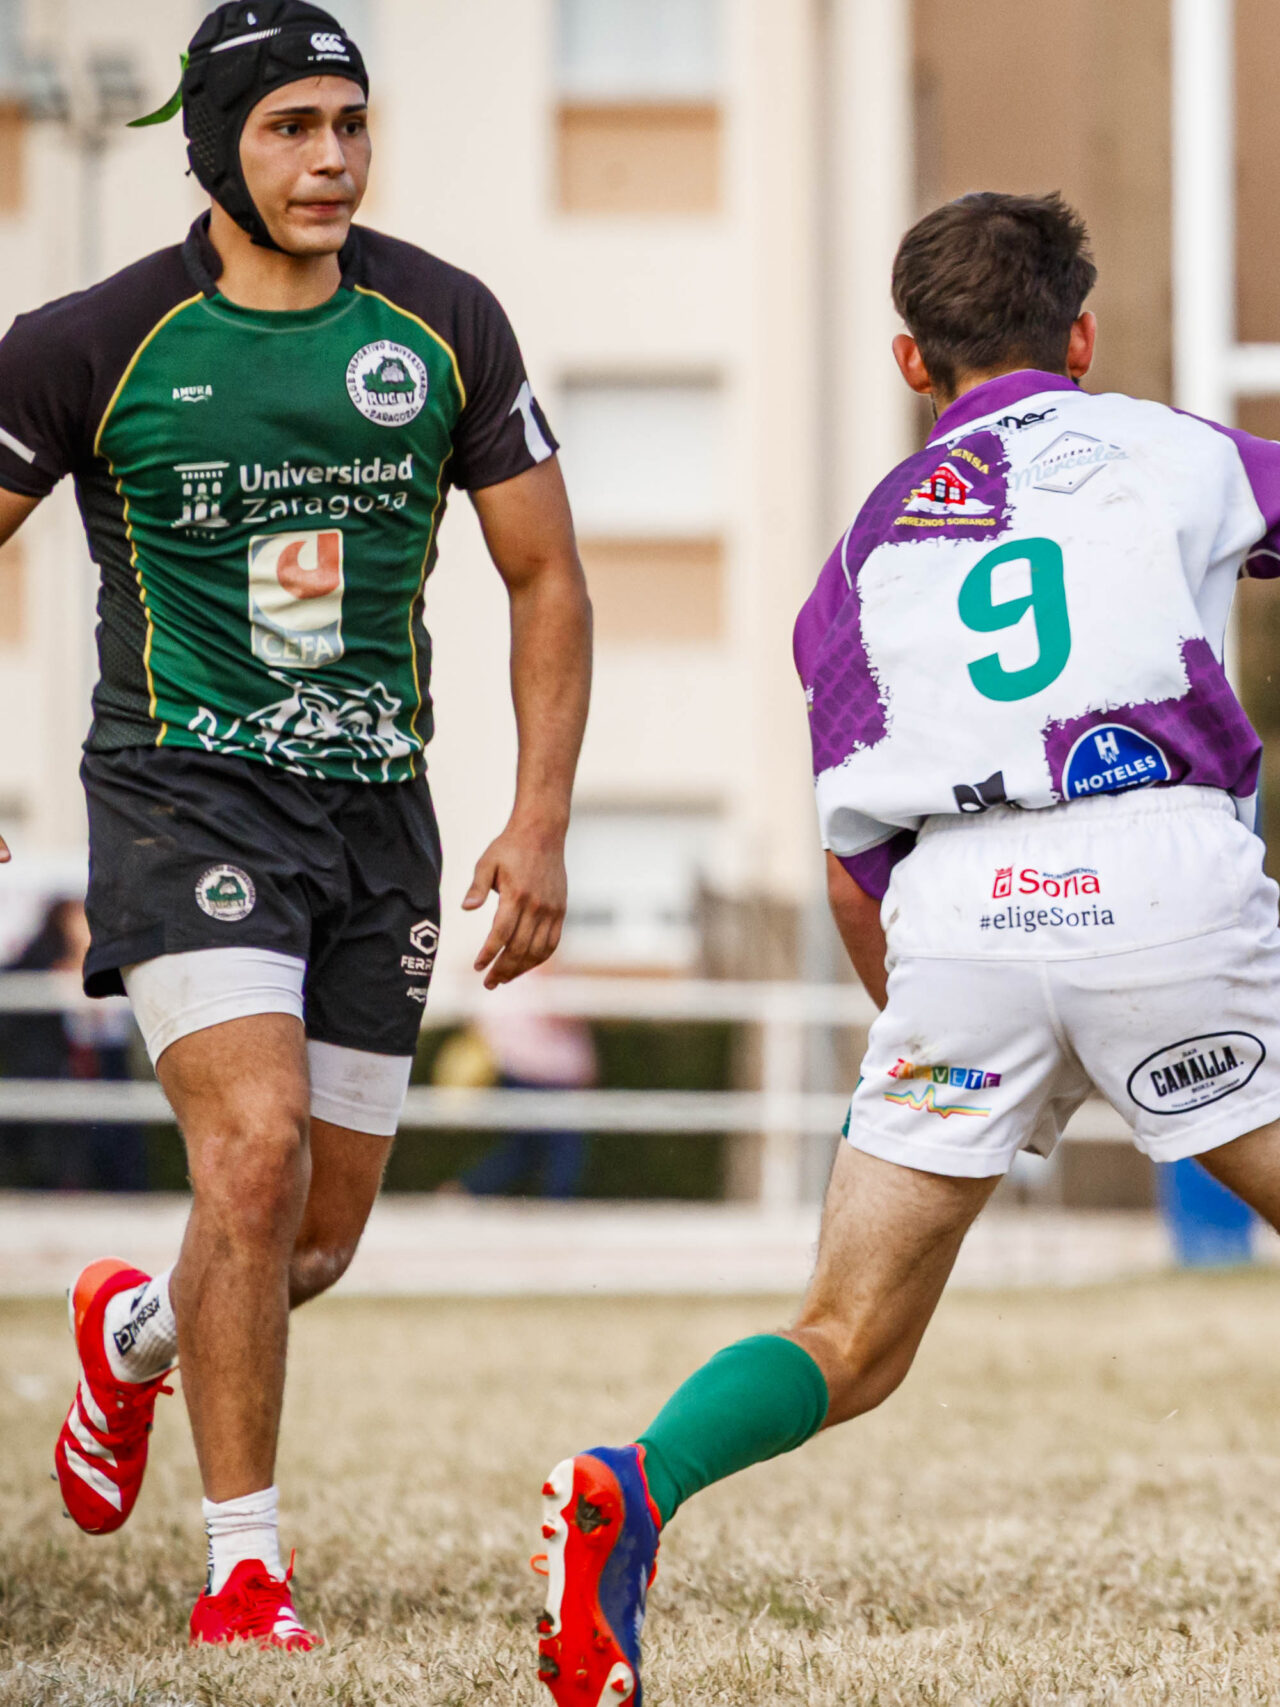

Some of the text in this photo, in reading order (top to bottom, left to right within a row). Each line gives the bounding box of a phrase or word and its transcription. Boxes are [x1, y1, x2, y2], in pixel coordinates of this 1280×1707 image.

[172, 384, 213, 401] AMURA
[367, 391, 415, 405] RUGBY
[369, 406, 416, 422] ZARAGOZA
[1042, 447, 1093, 467] TABERNA
[239, 453, 413, 493] Universidad
[241, 491, 408, 524] Zaragoza
[892, 516, 945, 528] ORREZNOS
[958, 537, 1071, 702] 9
[262, 635, 335, 661] CEFA
[1074, 755, 1157, 794] HOTELES
[980, 904, 1115, 933] #eligeSoria
